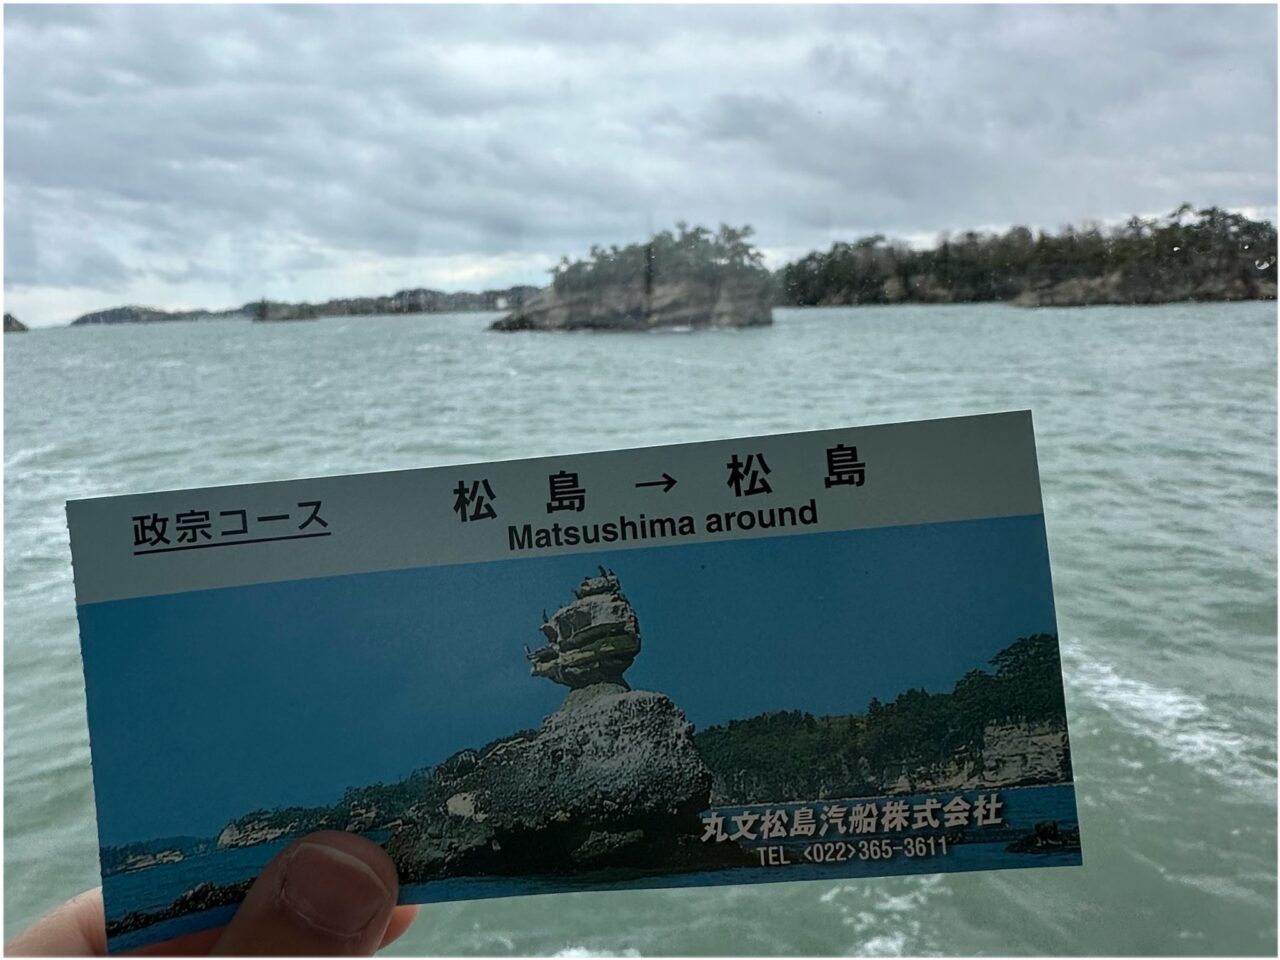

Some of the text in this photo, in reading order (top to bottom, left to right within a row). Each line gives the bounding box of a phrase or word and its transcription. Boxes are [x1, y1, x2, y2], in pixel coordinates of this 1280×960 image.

[132, 500, 330, 547] 政宗コース
[508, 499, 818, 550] Matsushima around
[700, 793, 1004, 843] 丸文松島汽船株式会社
[756, 846, 791, 866] TEL
